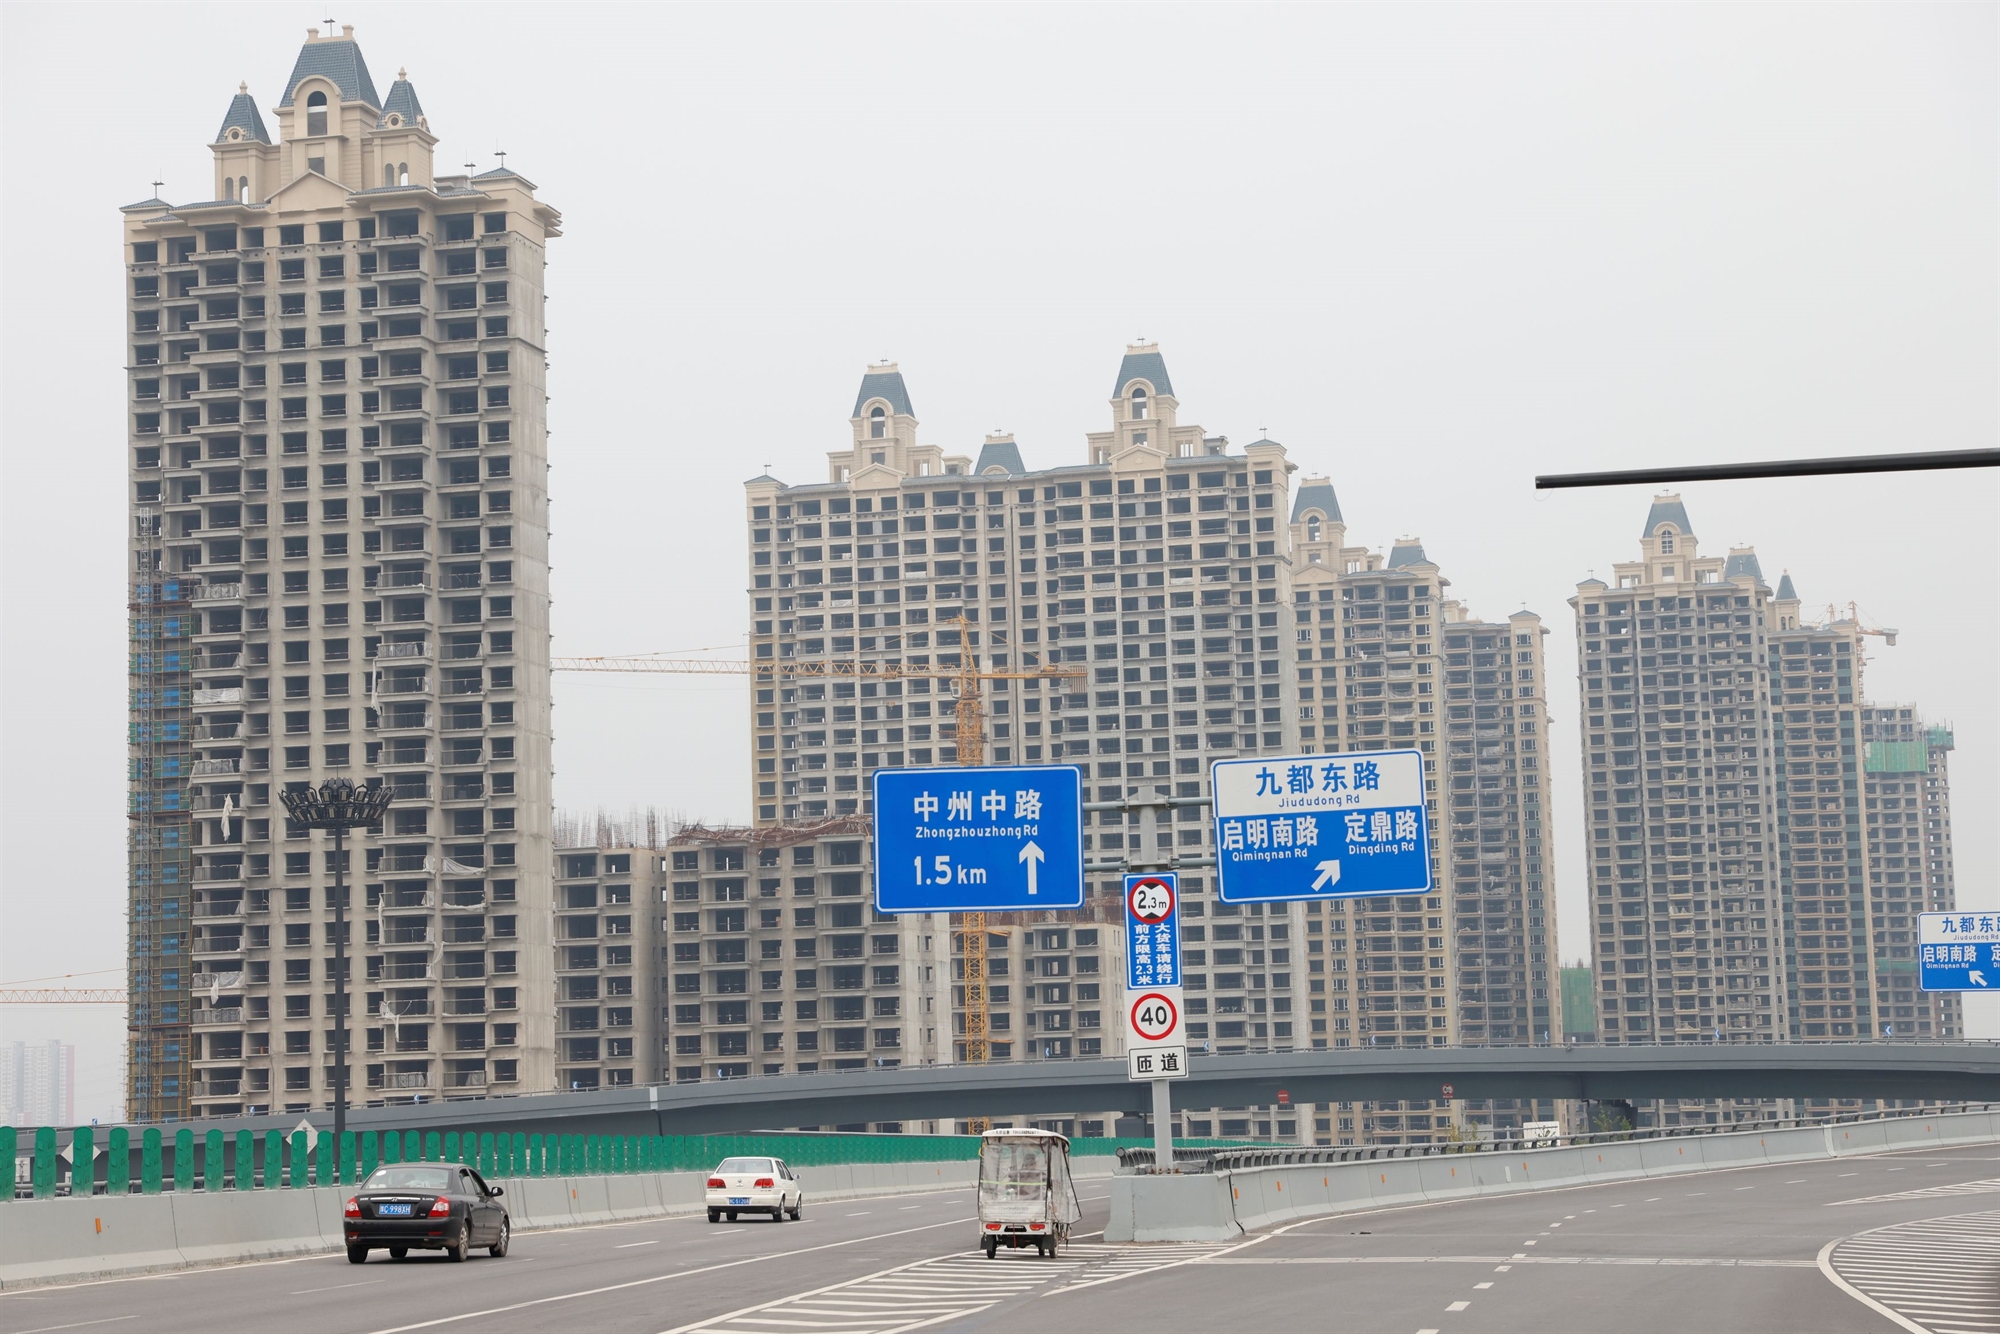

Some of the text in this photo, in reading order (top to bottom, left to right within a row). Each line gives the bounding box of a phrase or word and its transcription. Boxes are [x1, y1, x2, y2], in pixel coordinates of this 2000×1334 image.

[1255, 760, 1380, 797] 九都东路
[914, 788, 1043, 822] 中州中路
[1278, 794, 1360, 808] Jiududong Rd
[915, 824, 1038, 841] Zhongzhouzhong Rd
[1222, 815, 1319, 850] 启明南路
[1344, 809, 1419, 843] 定鼎路
[1232, 848, 1308, 862] Qimingnan Rd
[1348, 842, 1415, 856] Dingding Rd
[914, 855, 987, 885] 1.5 km
[1942, 917, 2000, 933] 九都东
[1154, 923, 1173, 984] 大货车请绕行
[1923, 946, 1976, 962] 启明南路
[1140, 1005, 1167, 1026] 40
[1137, 1053, 1179, 1073] 匝道
